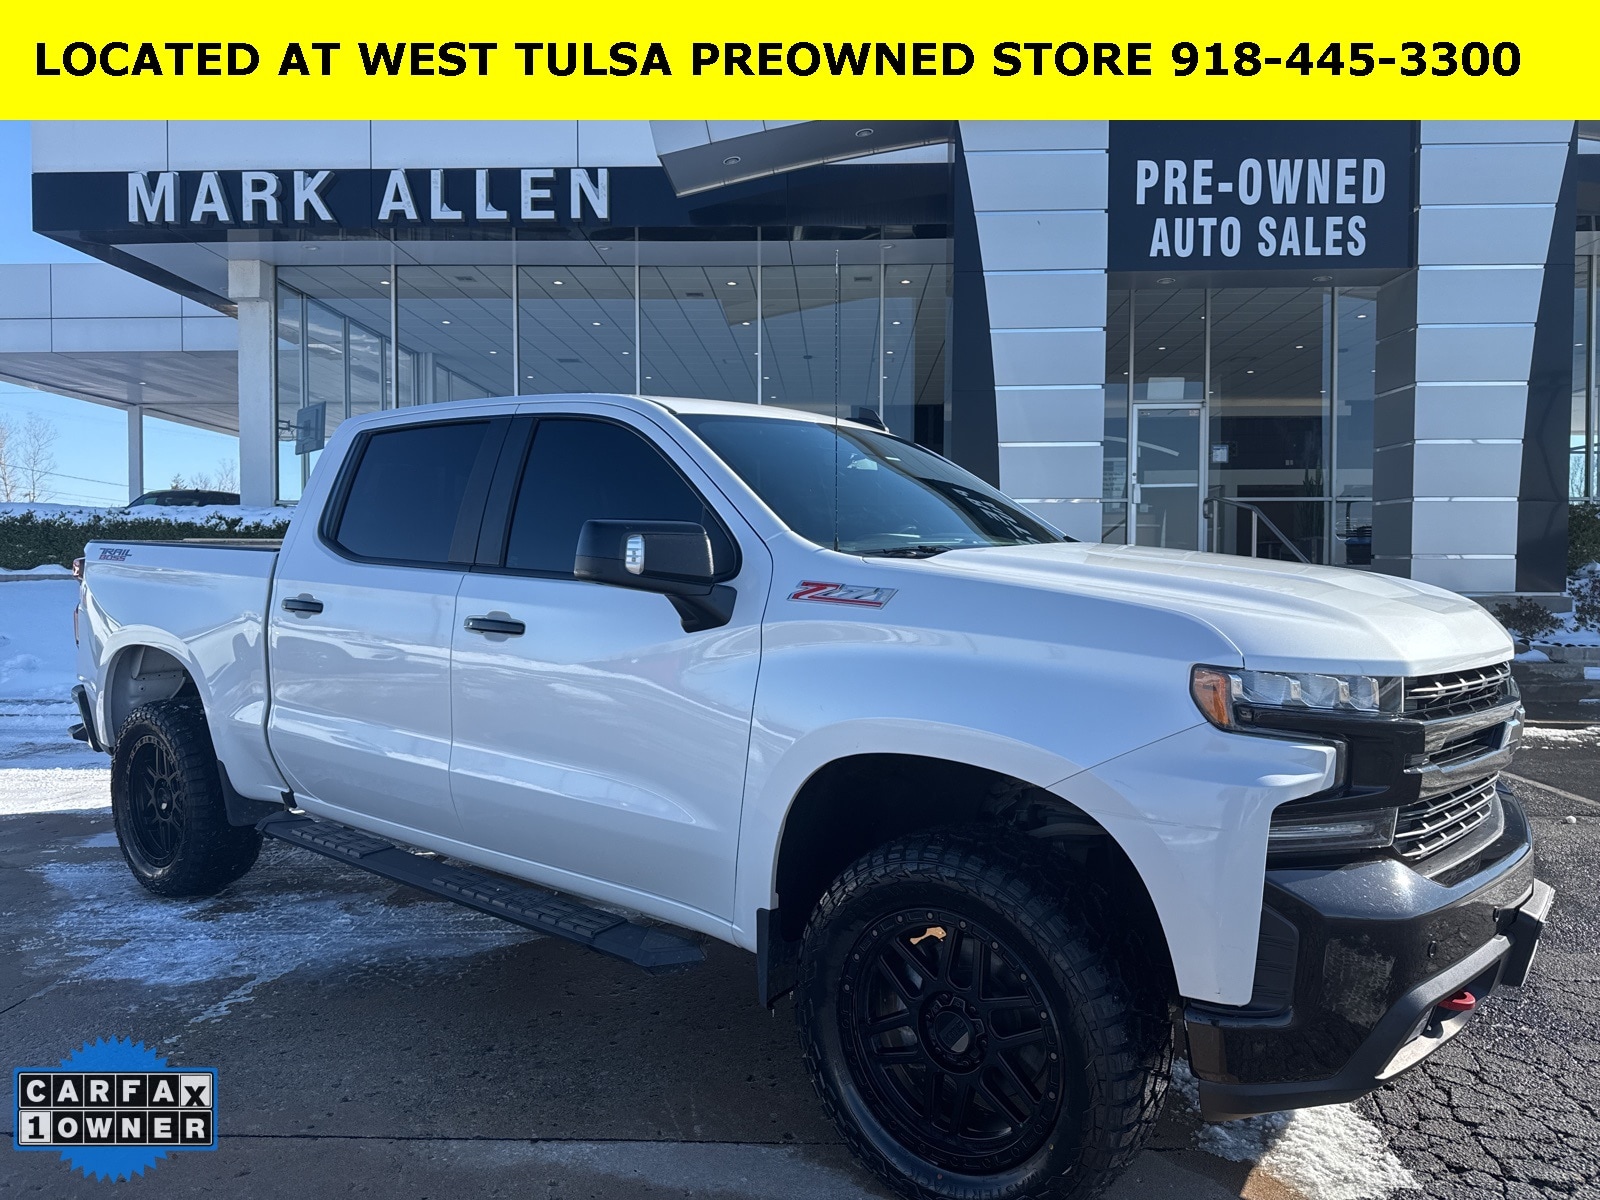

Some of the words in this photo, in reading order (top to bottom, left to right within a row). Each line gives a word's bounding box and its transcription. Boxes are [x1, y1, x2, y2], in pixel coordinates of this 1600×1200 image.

[127, 170, 335, 225] MARK
[378, 168, 611, 222] ALLEN
[1136, 158, 1386, 206] PRE-OWNED
[1149, 216, 1242, 258] AUTO
[1257, 215, 1367, 257] SALES
[98, 554, 127, 562] BOSS
[99, 547, 133, 557] TRAIL
[786, 580, 899, 611] Z71
